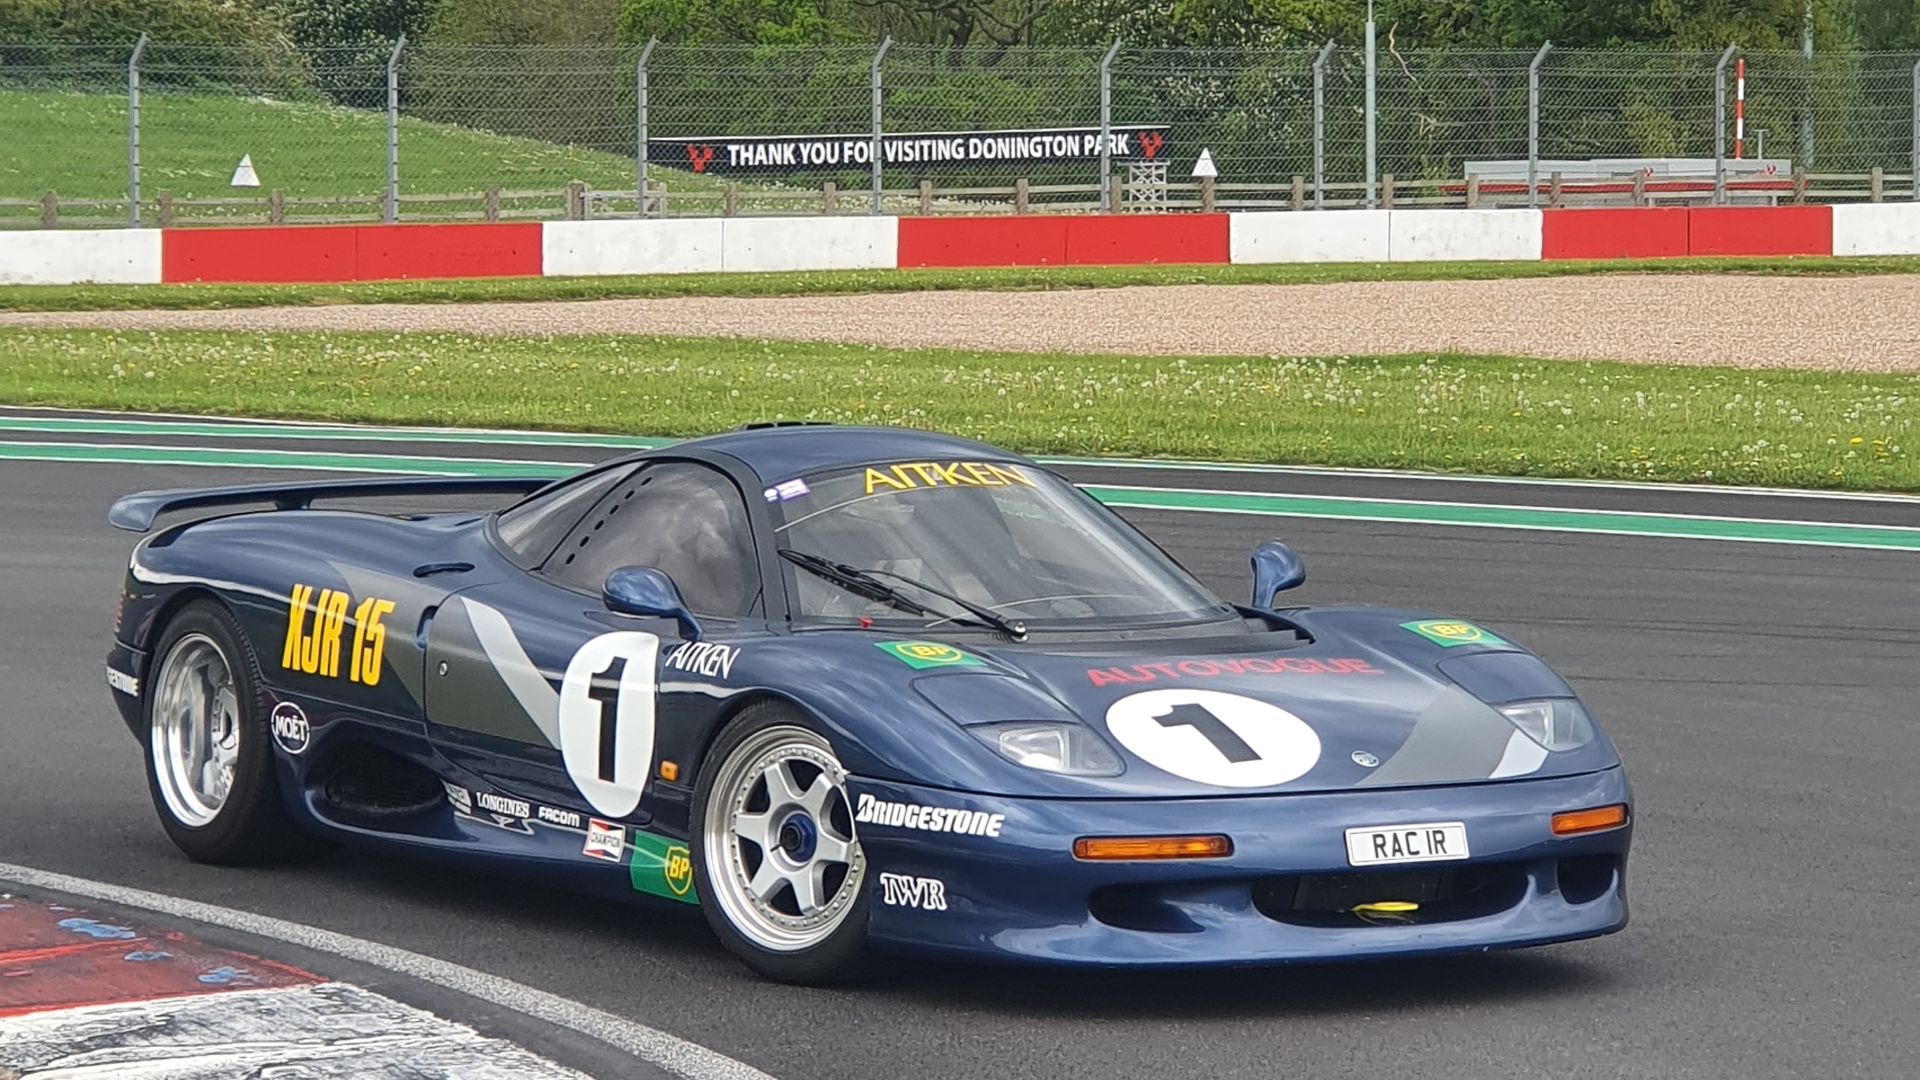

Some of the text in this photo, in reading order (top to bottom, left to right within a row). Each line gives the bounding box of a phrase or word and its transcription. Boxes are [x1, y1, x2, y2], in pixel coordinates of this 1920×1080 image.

[727, 143, 796, 166] THANK
[799, 142, 839, 164] YOU
[884, 138, 965, 162] VISITING
[969, 135, 1080, 159] DONINGTON
[864, 461, 1037, 496] AITKEN
[281, 583, 396, 687] XJR 15
[1433, 623, 1470, 636] BP
[665, 641, 741, 680] AITKEN
[911, 644, 951, 658] BP
[1087, 657, 1385, 687] AUTOVOGUE
[588, 657, 628, 784] 1
[1151, 703, 1263, 764] 1
[476, 792, 530, 818] LONGINES
[855, 793, 1006, 838] BRIDGESTONE
[1372, 831, 1420, 859] RAC
[669, 855, 690, 880] BP
[879, 872, 948, 911] TWR
